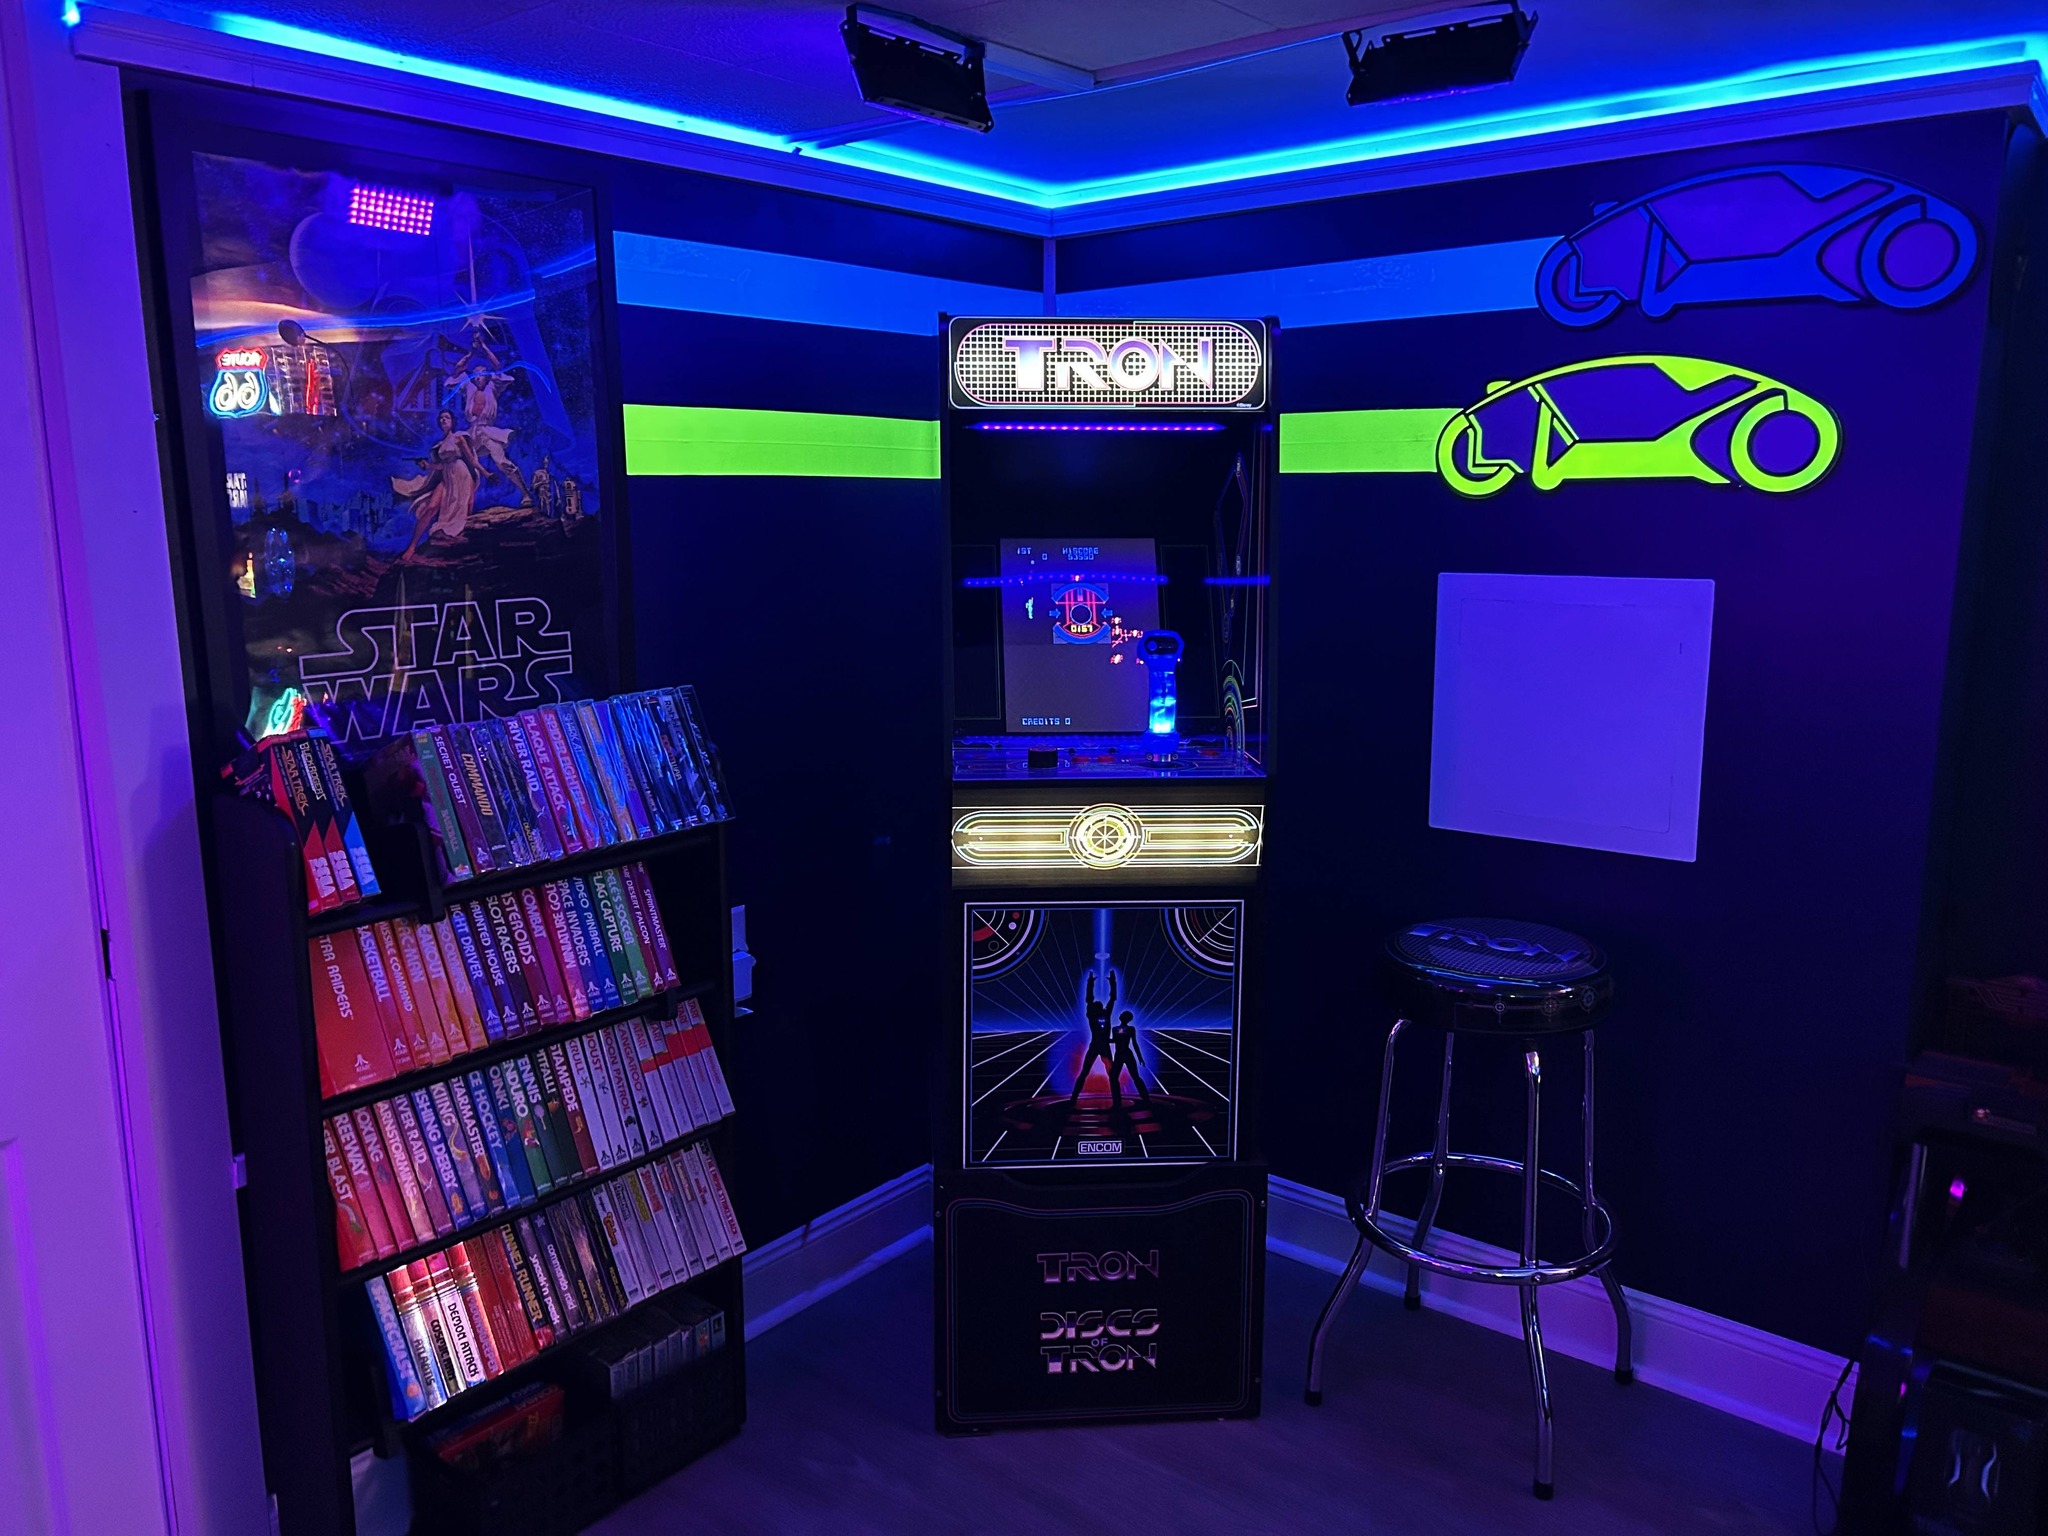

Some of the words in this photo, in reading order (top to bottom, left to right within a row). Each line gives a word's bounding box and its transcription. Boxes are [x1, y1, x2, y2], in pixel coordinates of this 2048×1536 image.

[1004, 337, 1213, 391] TRON
[300, 597, 572, 680] STAR
[302, 654, 573, 743] WARS
[562, 712, 579, 741] SHARK
[1022, 717, 1060, 726] CREDITS
[434, 735, 453, 770] SECRET
[447, 772, 465, 805] QUEST
[506, 720, 528, 758] RIVER
[520, 758, 539, 792] RAID
[524, 714, 548, 764] PLAQUE
[541, 764, 565, 810] ATTACK
[544, 712, 566, 755] SPIDER
[559, 755, 585, 806] FIGHTER
[461, 751, 493, 818] COMMANDO
[520, 886, 546, 940] COMBAT
[544, 881, 562, 911] GOLF
[614, 903, 634, 945] SOCCER
[625, 879, 639, 909] DESERT
[635, 910, 651, 944] FALCON
[643, 888, 666, 949] SPRINTMASTER
[394, 915, 425, 983] PAC-MAN
[416, 923, 443, 980] EAKOUT
[436, 920, 450, 942] DEO
[485, 894, 504, 926] SLOT
[495, 925, 520, 974] RACERS
[551, 911, 576, 969] MINIATURE
[565, 909, 590, 965] INVADERS
[582, 910, 604, 956] PINBALL
[598, 898, 623, 952] CAPTURE
[317, 934, 335, 962] TAR
[326, 964, 352, 1018] RAIDERS
[356, 924, 390, 1002] BASKETBALL
[378, 920, 395, 955] MISSILE
[388, 955, 413, 1012] COMMAND
[442, 942, 466, 993] OLYMPICS
[460, 935, 483, 979] DRIVER
[484, 948, 504, 986] HOUSE
[568, 1038, 585, 1074] KRULL
[585, 1033, 602, 1072] JOUST
[616, 1022, 643, 1092] KANGAROO
[632, 1021, 647, 1049] ATARI
[649, 1021, 662, 1042] TARI
[468, 1071, 481, 1086] CE
[487, 1065, 509, 1110] OINK!
[549, 1043, 578, 1112] STAMPEDE
[601, 1027, 619, 1065] MOON
[612, 1068, 631, 1113] PATROL
[430, 1082, 456, 1127] KIING
[450, 1075, 485, 1158] STARMASTER
[474, 1089, 502, 1150] HOCKEY
[333, 1113, 368, 1178] REEWAY
[354, 1107, 384, 1163] OXING
[376, 1101, 417, 1197] ARNSTORMING
[406, 1129, 427, 1165] RAID
[414, 1087, 441, 1142] ISHING
[432, 1143, 458, 1190] DERBY
[1080, 1142, 1122, 1152] ENCOM
[326, 1157, 352, 1201] BLAST
[499, 1223, 524, 1269] TUNNEL
[515, 1268, 543, 1322] RUNNER
[546, 1243, 570, 1290] commando
[563, 1292, 576, 1309] raid
[1037, 1250, 1160, 1284] TRON
[369, 1283, 413, 1379] SPACECHASE
[429, 1319, 449, 1358] COSMIC
[447, 1303, 467, 1340] DEMON
[459, 1341, 479, 1377] ATTACK
[465, 1295, 499, 1373] MOONSWEEPER
[1040, 1308, 1161, 1340] DISCS
[1091, 1338, 1108, 1347] OF
[412, 1339, 436, 1386] ATLANTIS
[1040, 1343, 1157, 1374] TRON
